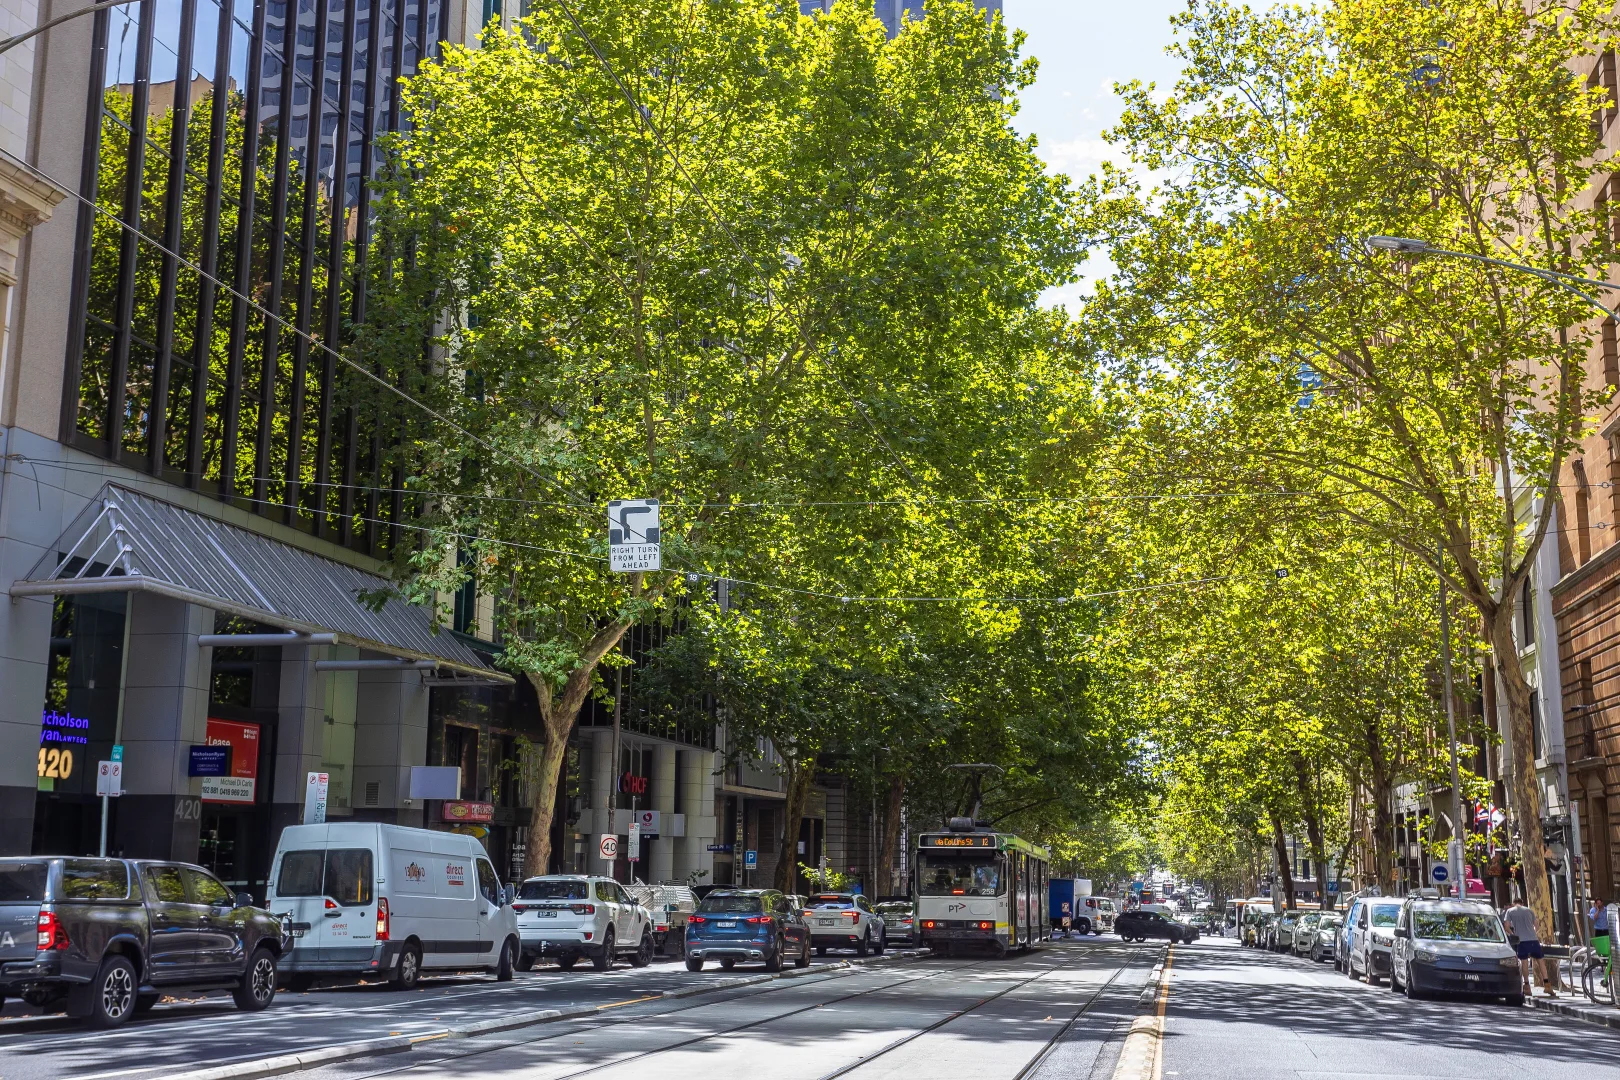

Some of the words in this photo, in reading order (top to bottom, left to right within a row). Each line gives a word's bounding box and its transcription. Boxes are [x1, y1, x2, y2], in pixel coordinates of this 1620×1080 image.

[1277, 569, 1287, 577] 18
[42, 710, 89, 729] icholson
[40, 729, 60, 743] yan
[60, 735, 87, 744] LAWYERS
[37, 747, 73, 779] 420
[631, 776, 648, 793] HCF
[175, 799, 200, 820] 420
[316, 802, 325, 810] 2P
[603, 842, 617, 852] 40
[934, 838, 944, 846] via
[944, 838, 965, 846] Collins
[965, 838, 973, 846] St
[982, 838, 989, 846] 12
[748, 853, 754, 862] P
[0, 931, 15, 948] A
